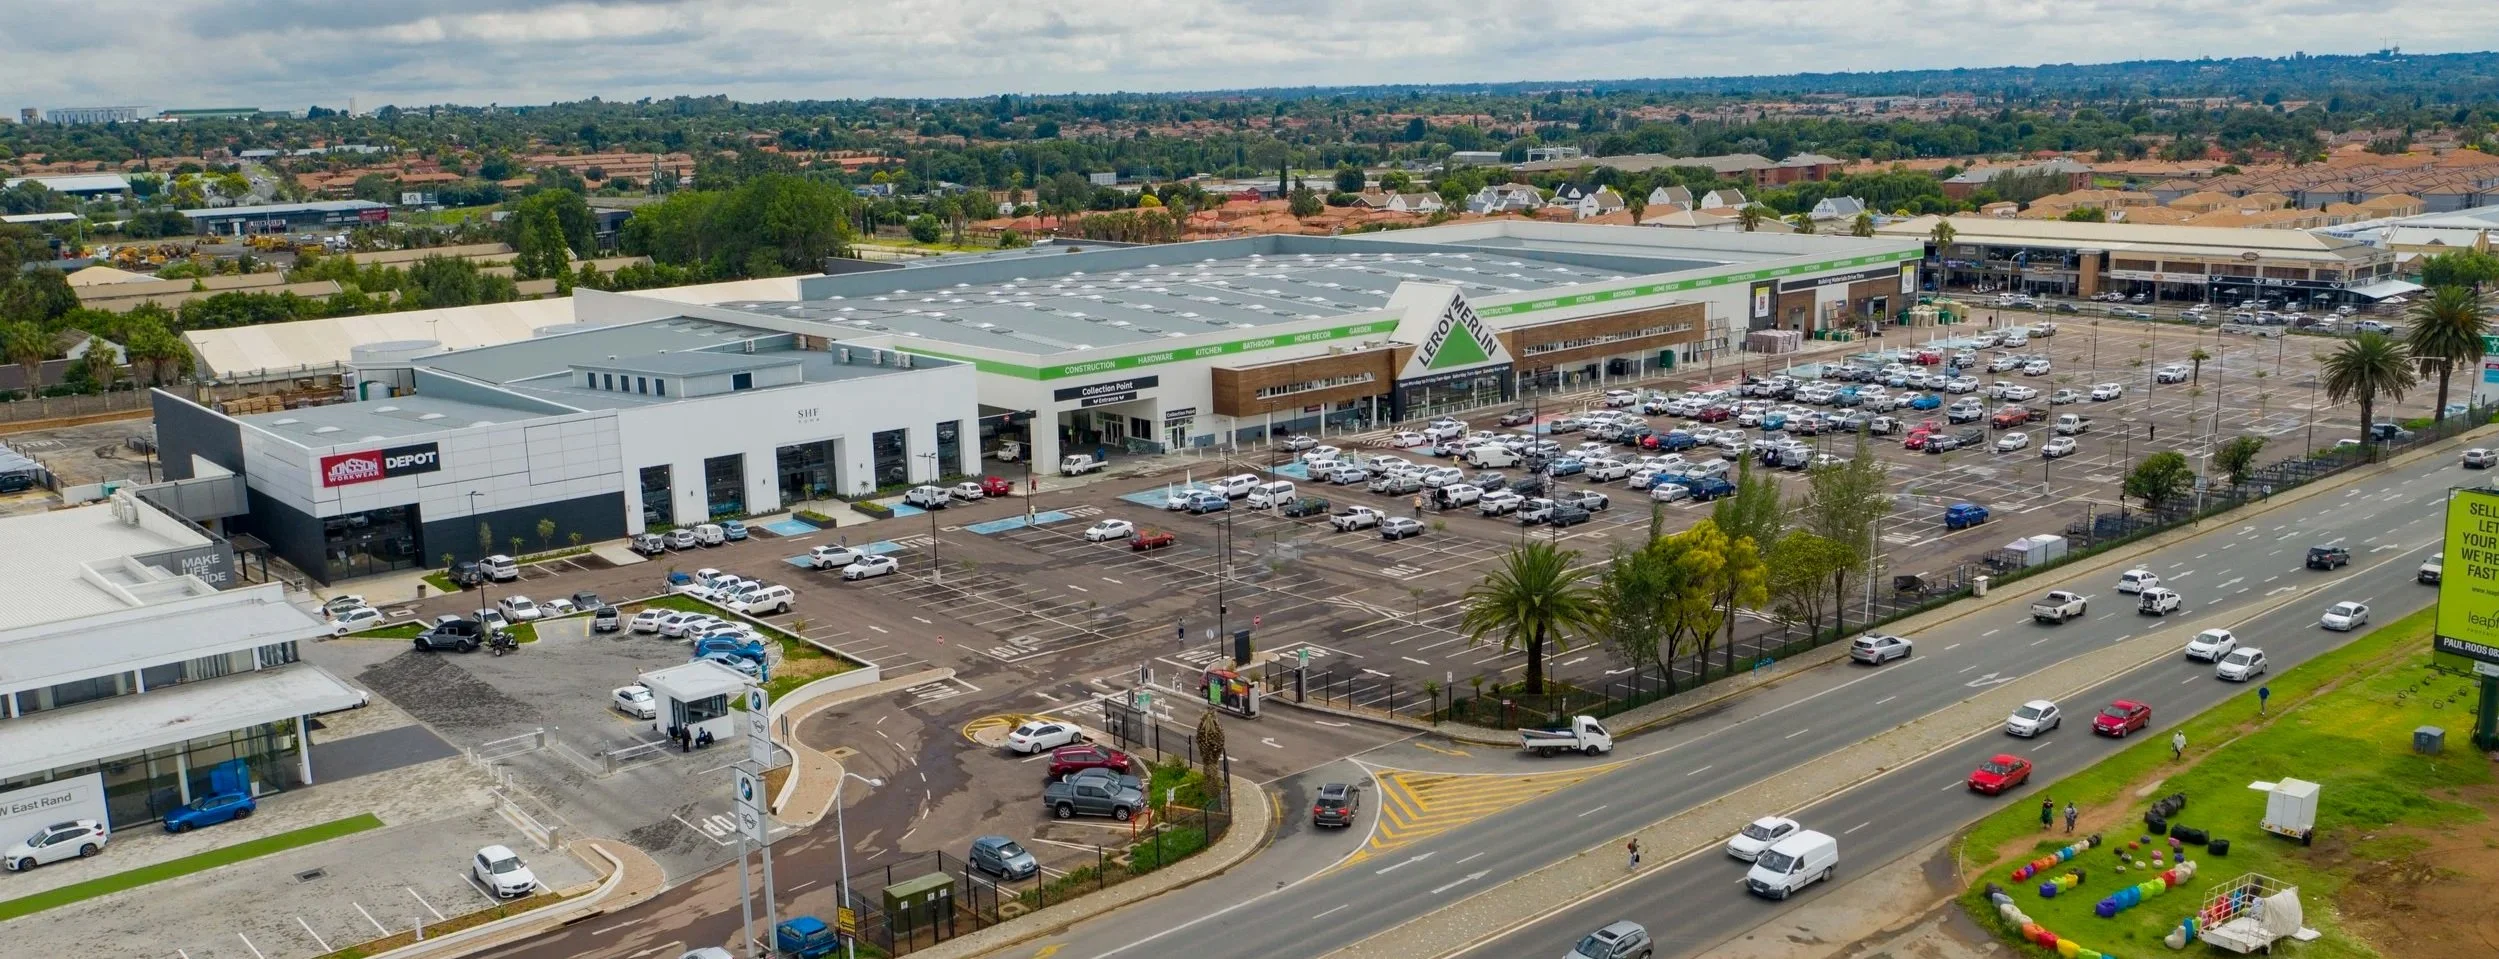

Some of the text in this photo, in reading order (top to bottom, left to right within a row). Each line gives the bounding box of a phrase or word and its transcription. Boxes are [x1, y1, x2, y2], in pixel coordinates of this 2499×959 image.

[1418, 294, 1498, 368] LEROY MERLIN
[1065, 326, 1372, 375] CONSTRUCTION HARDWARE KITCHEN BATHROOM HOME DECOR GARDEN
[1082, 381, 1133, 396] Collection Point
[328, 458, 378, 476] JONSSON
[385, 452, 436, 470] DEPOT
[328, 471, 380, 482] WORKWEAR
[2463, 532, 2497, 550] YOUR
[182, 554, 220, 568] MAKE
[2462, 547, 2499, 566] WE'RE
[2468, 564, 2499, 580] FAST
[2444, 637, 2464, 650] PAUL
[2465, 642, 2488, 655] ROOS
[12, 800, 38, 814] East
[41, 792, 72, 807] Rand
